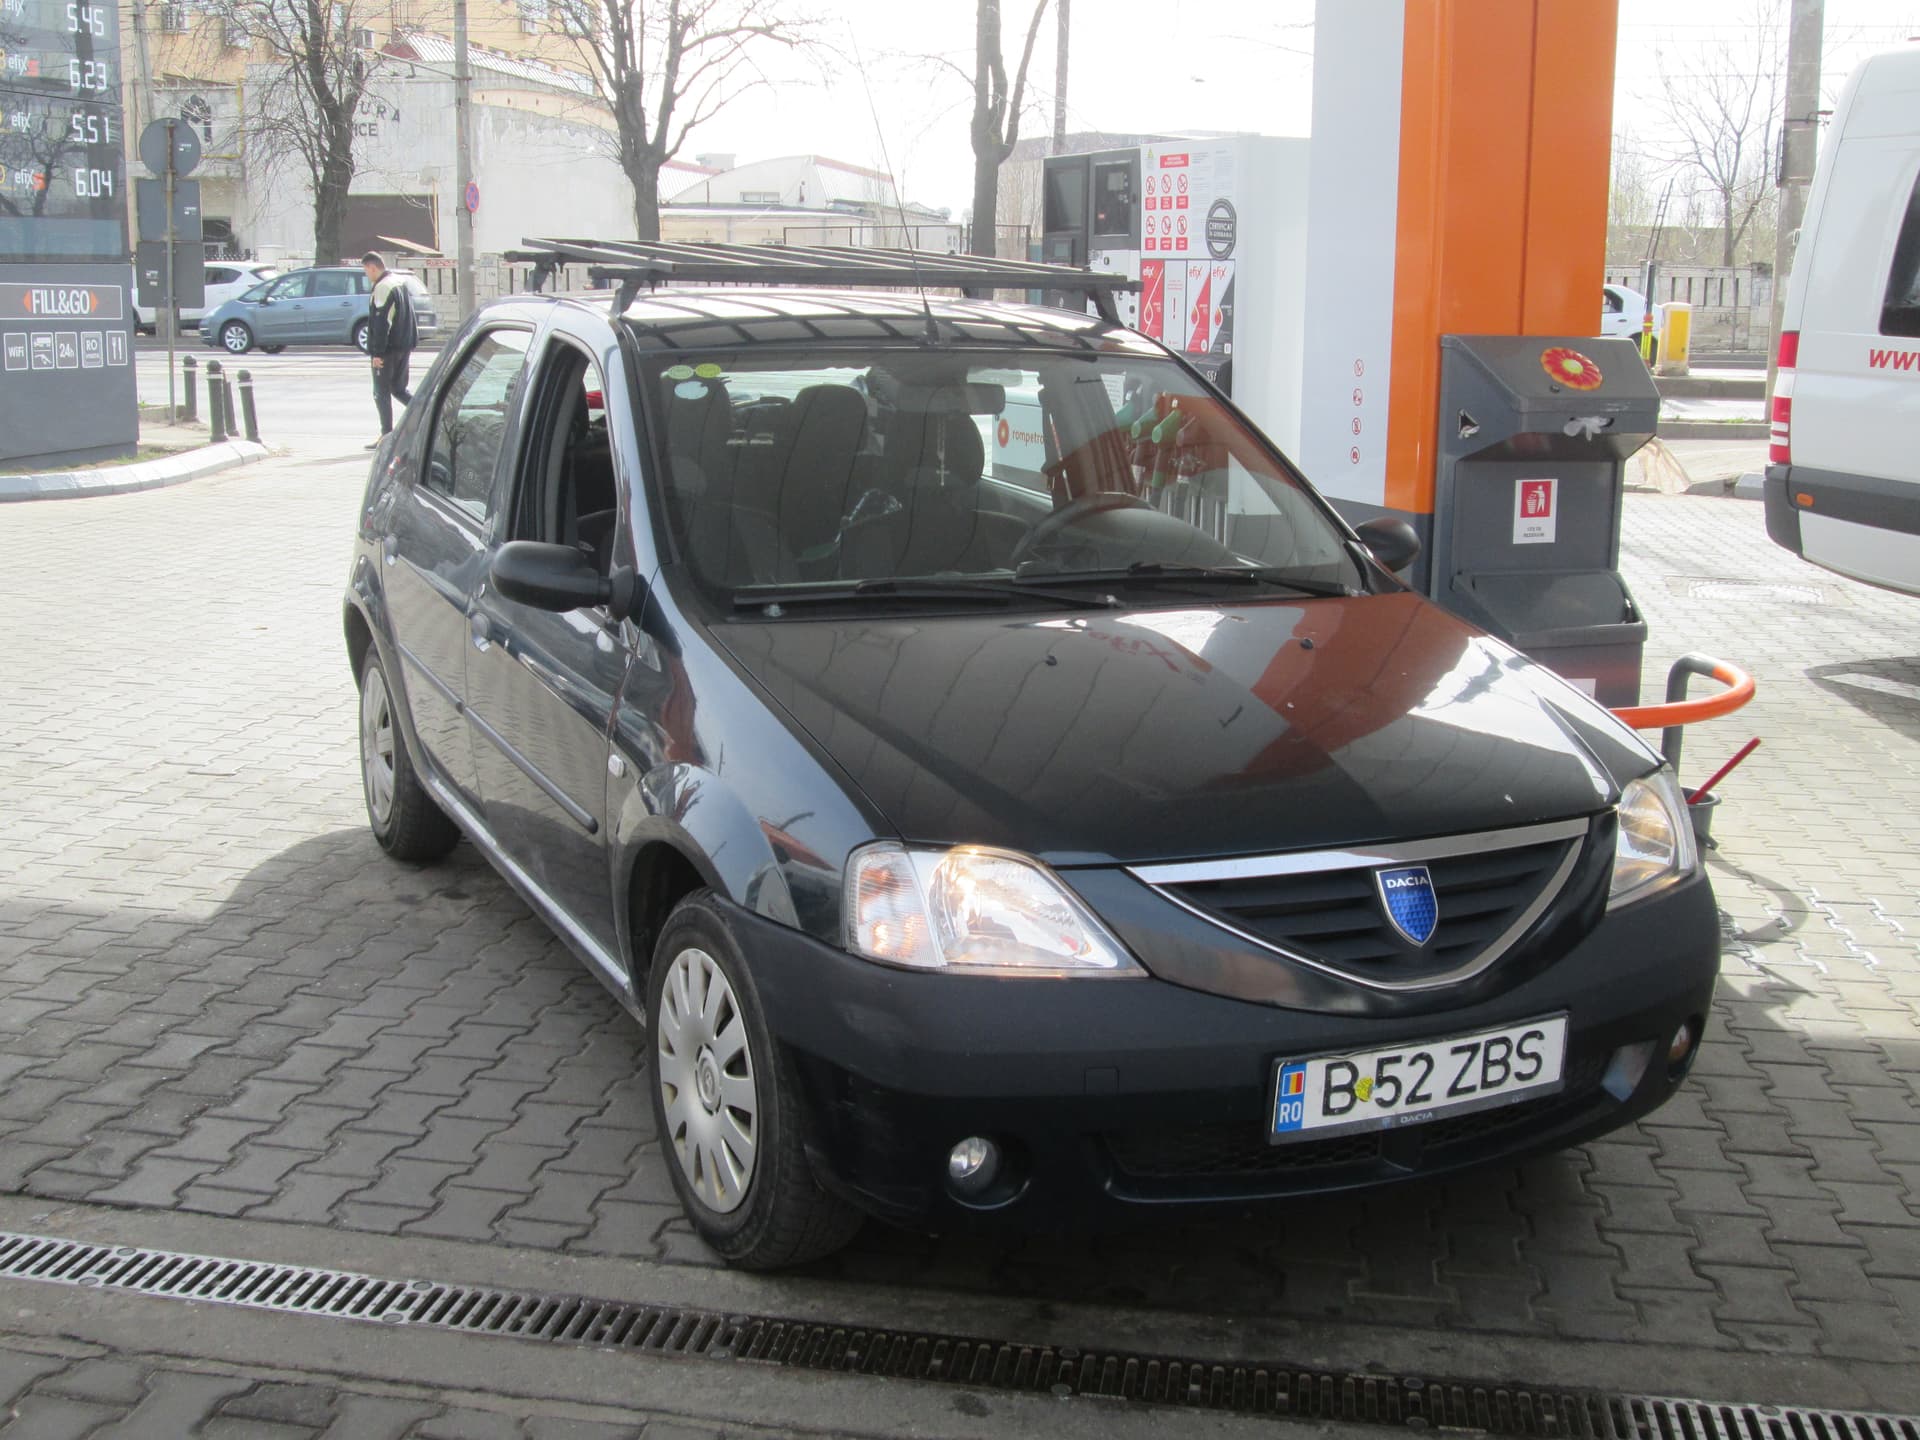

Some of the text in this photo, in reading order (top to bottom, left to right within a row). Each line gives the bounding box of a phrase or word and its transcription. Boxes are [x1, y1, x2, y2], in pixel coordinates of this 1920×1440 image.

[67, 4, 104, 36] 5.45
[69, 59, 107, 90] 6.23
[72, 114, 109, 144] 5.51
[75, 168, 112, 197] 6.04
[32, 288, 90, 315] FILL&GO
[1869, 348, 1920, 372] ww
[1012, 430, 1045, 448] rompetro
[1385, 876, 1429, 889] DACIA
[1374, 1051, 1435, 1109] 52
[1446, 1029, 1546, 1099] ZBS
[1279, 1101, 1301, 1124] RO
[1400, 1111, 1433, 1124] DACIA
